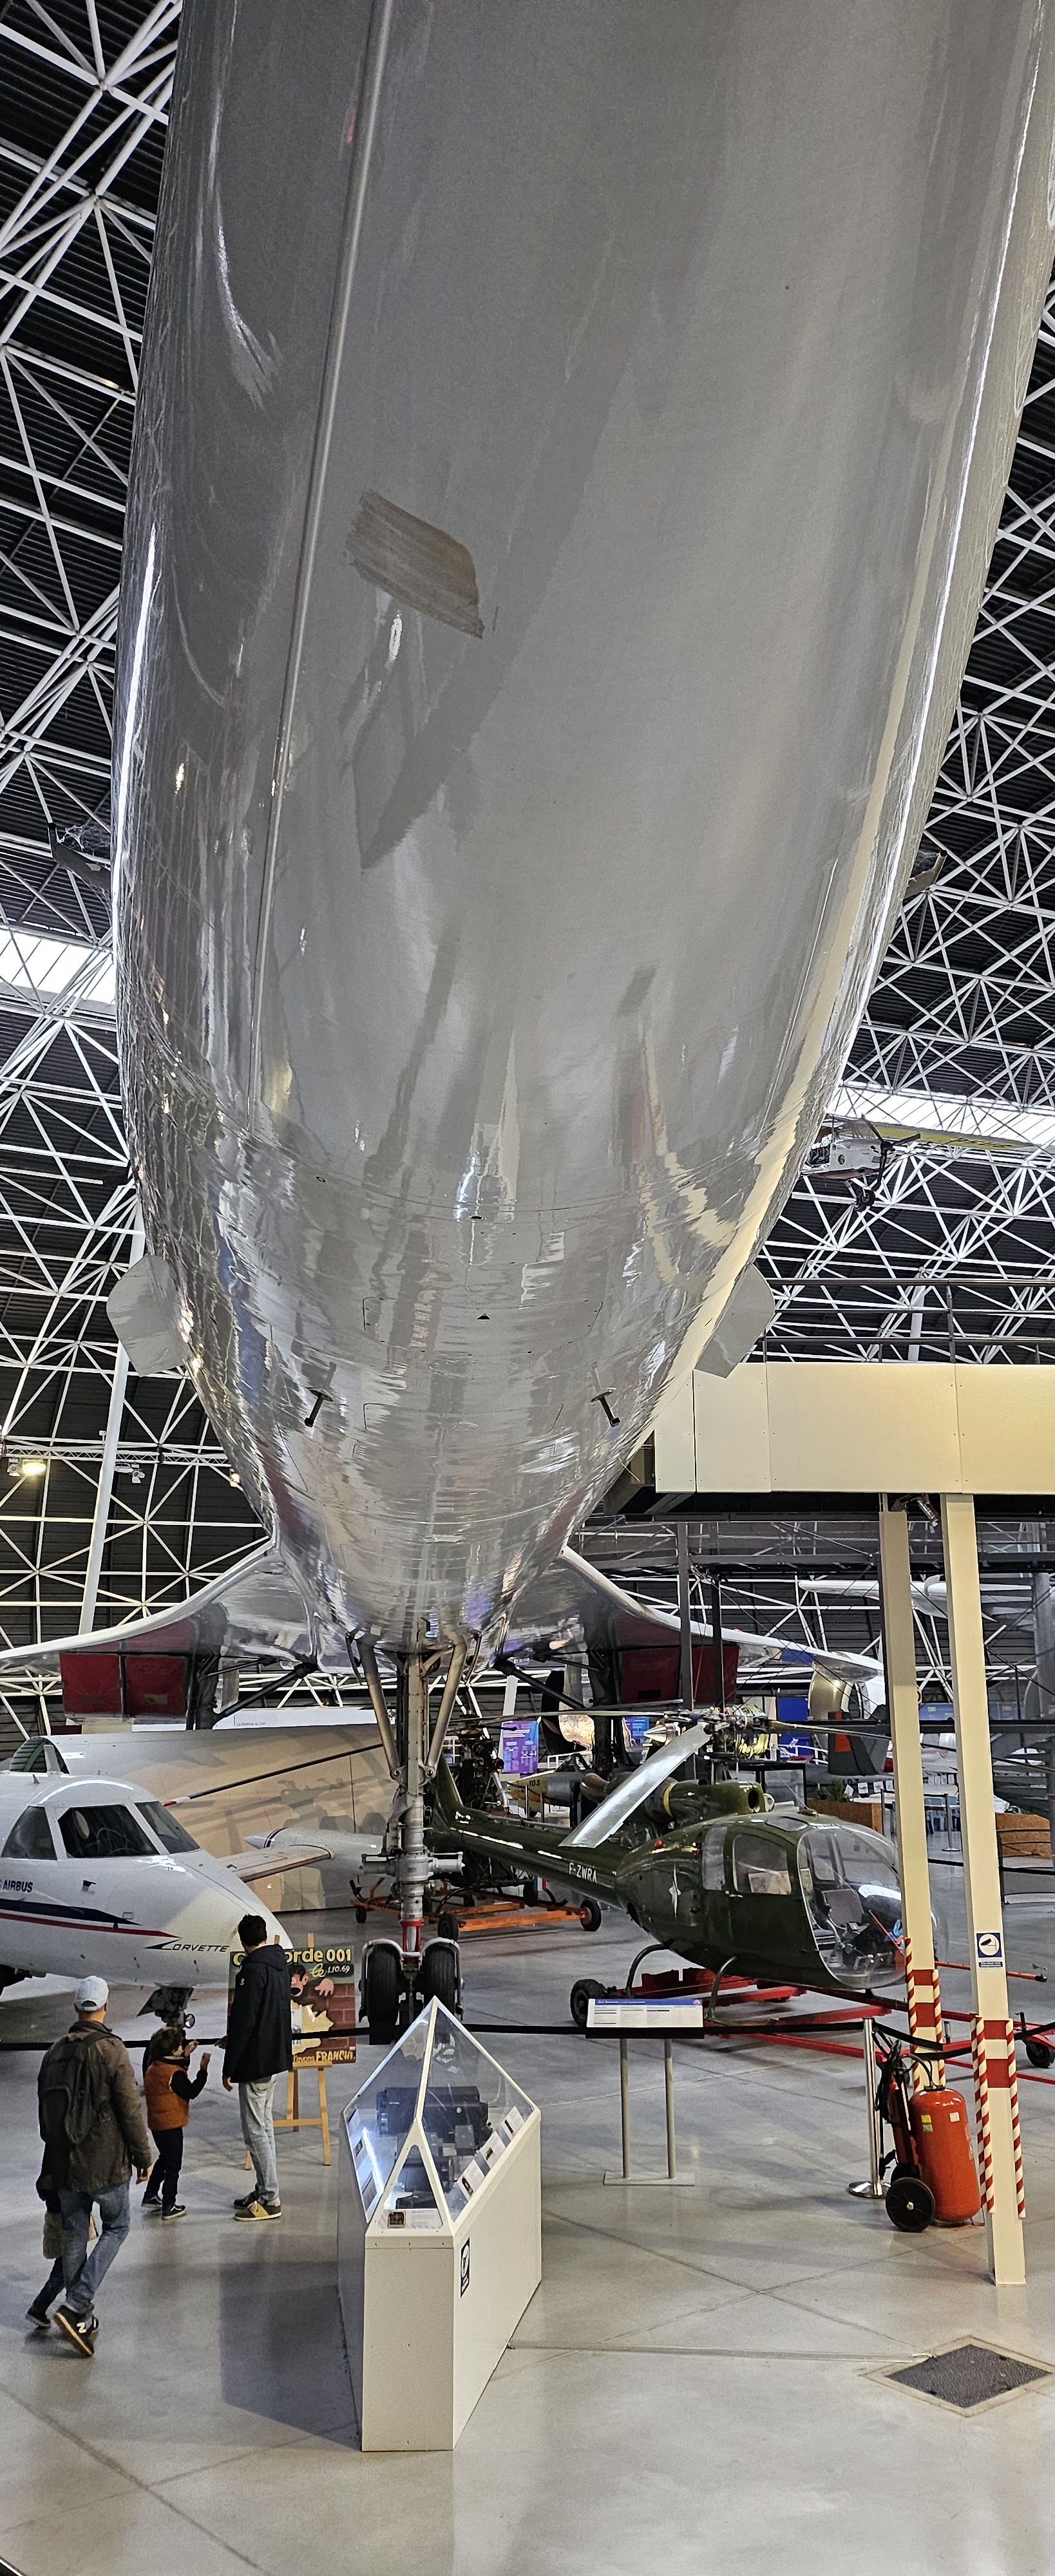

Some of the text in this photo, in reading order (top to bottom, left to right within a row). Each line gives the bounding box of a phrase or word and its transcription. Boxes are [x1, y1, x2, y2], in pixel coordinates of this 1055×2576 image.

[569, 1862, 598, 1884] F-ZWRA
[2, 1880, 33, 1893] AIRBUS
[143, 1937, 230, 1953] CORVETTE
[233, 1948, 351, 1966] Corde 001
